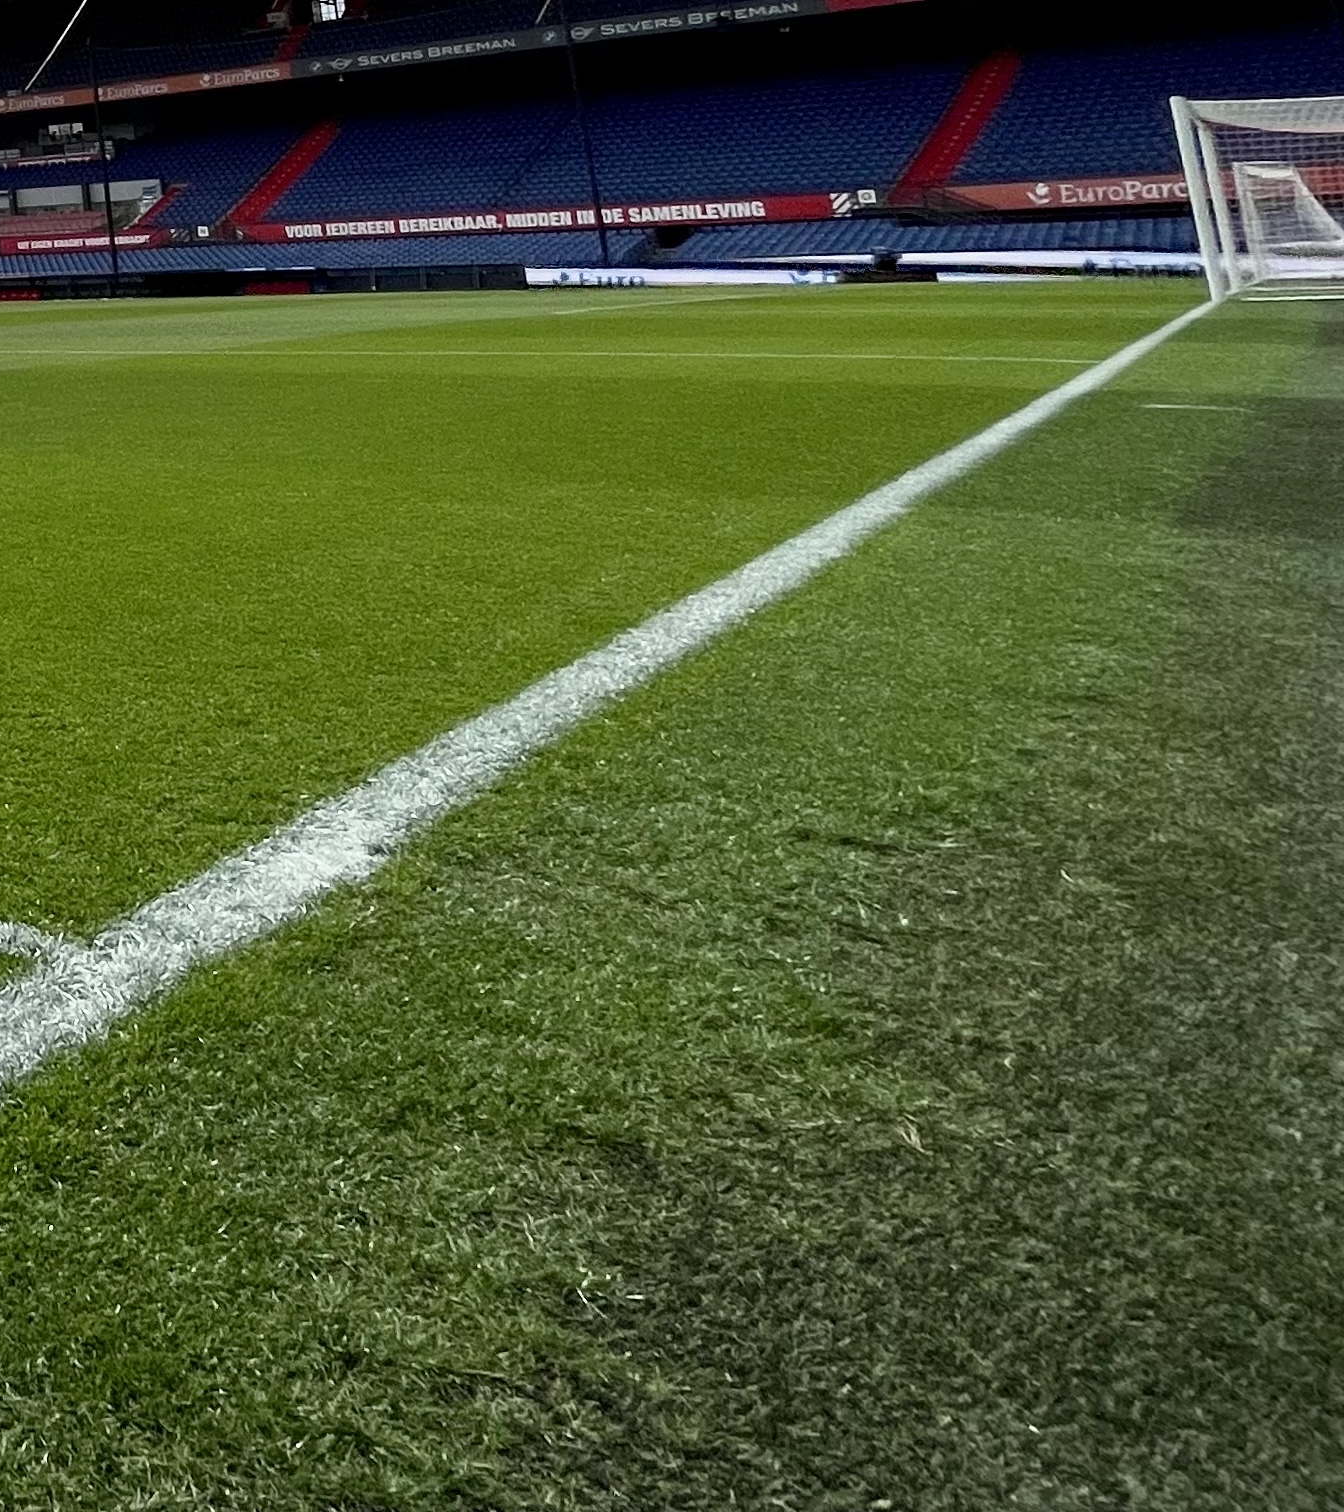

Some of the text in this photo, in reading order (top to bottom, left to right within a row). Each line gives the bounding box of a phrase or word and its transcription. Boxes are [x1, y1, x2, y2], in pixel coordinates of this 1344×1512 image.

[601, 17, 683, 36] SEVERS
[357, 38, 516, 67] SEVERS BREEMAN
[214, 68, 280, 86] EuroParcs
[107, 83, 168, 99] EuroParcs
[8, 95, 65, 111] EuroParcs
[1059, 180, 1189, 204] EuroParc
[284, 200, 767, 239] VOOR IEDEREEN BEREIKBAAR, MIDDEN IN DE SAMENLEVING
